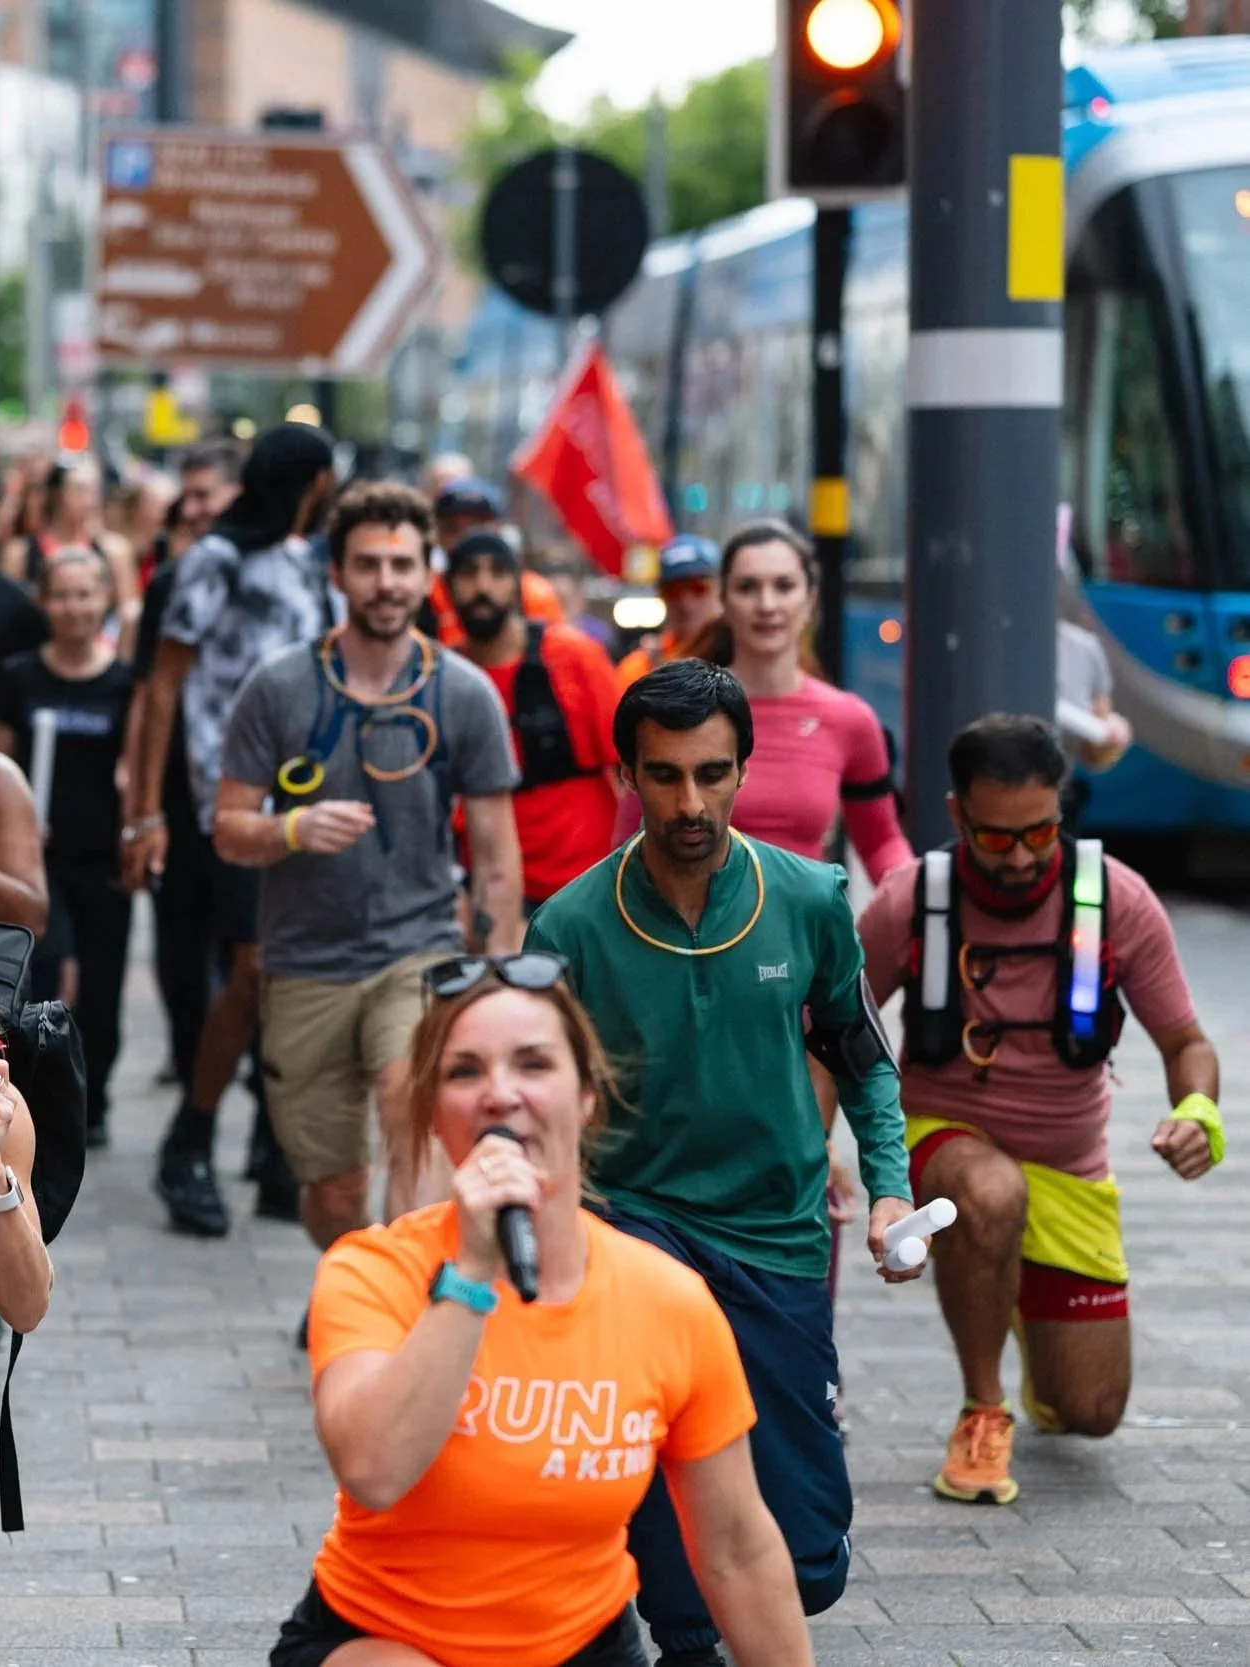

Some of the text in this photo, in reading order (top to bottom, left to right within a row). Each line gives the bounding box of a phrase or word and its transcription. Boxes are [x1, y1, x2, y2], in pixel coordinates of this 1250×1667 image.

[758, 962, 788, 982] EVERLAST
[453, 1374, 659, 1446] RUN OF
[540, 1448, 566, 1479] A
